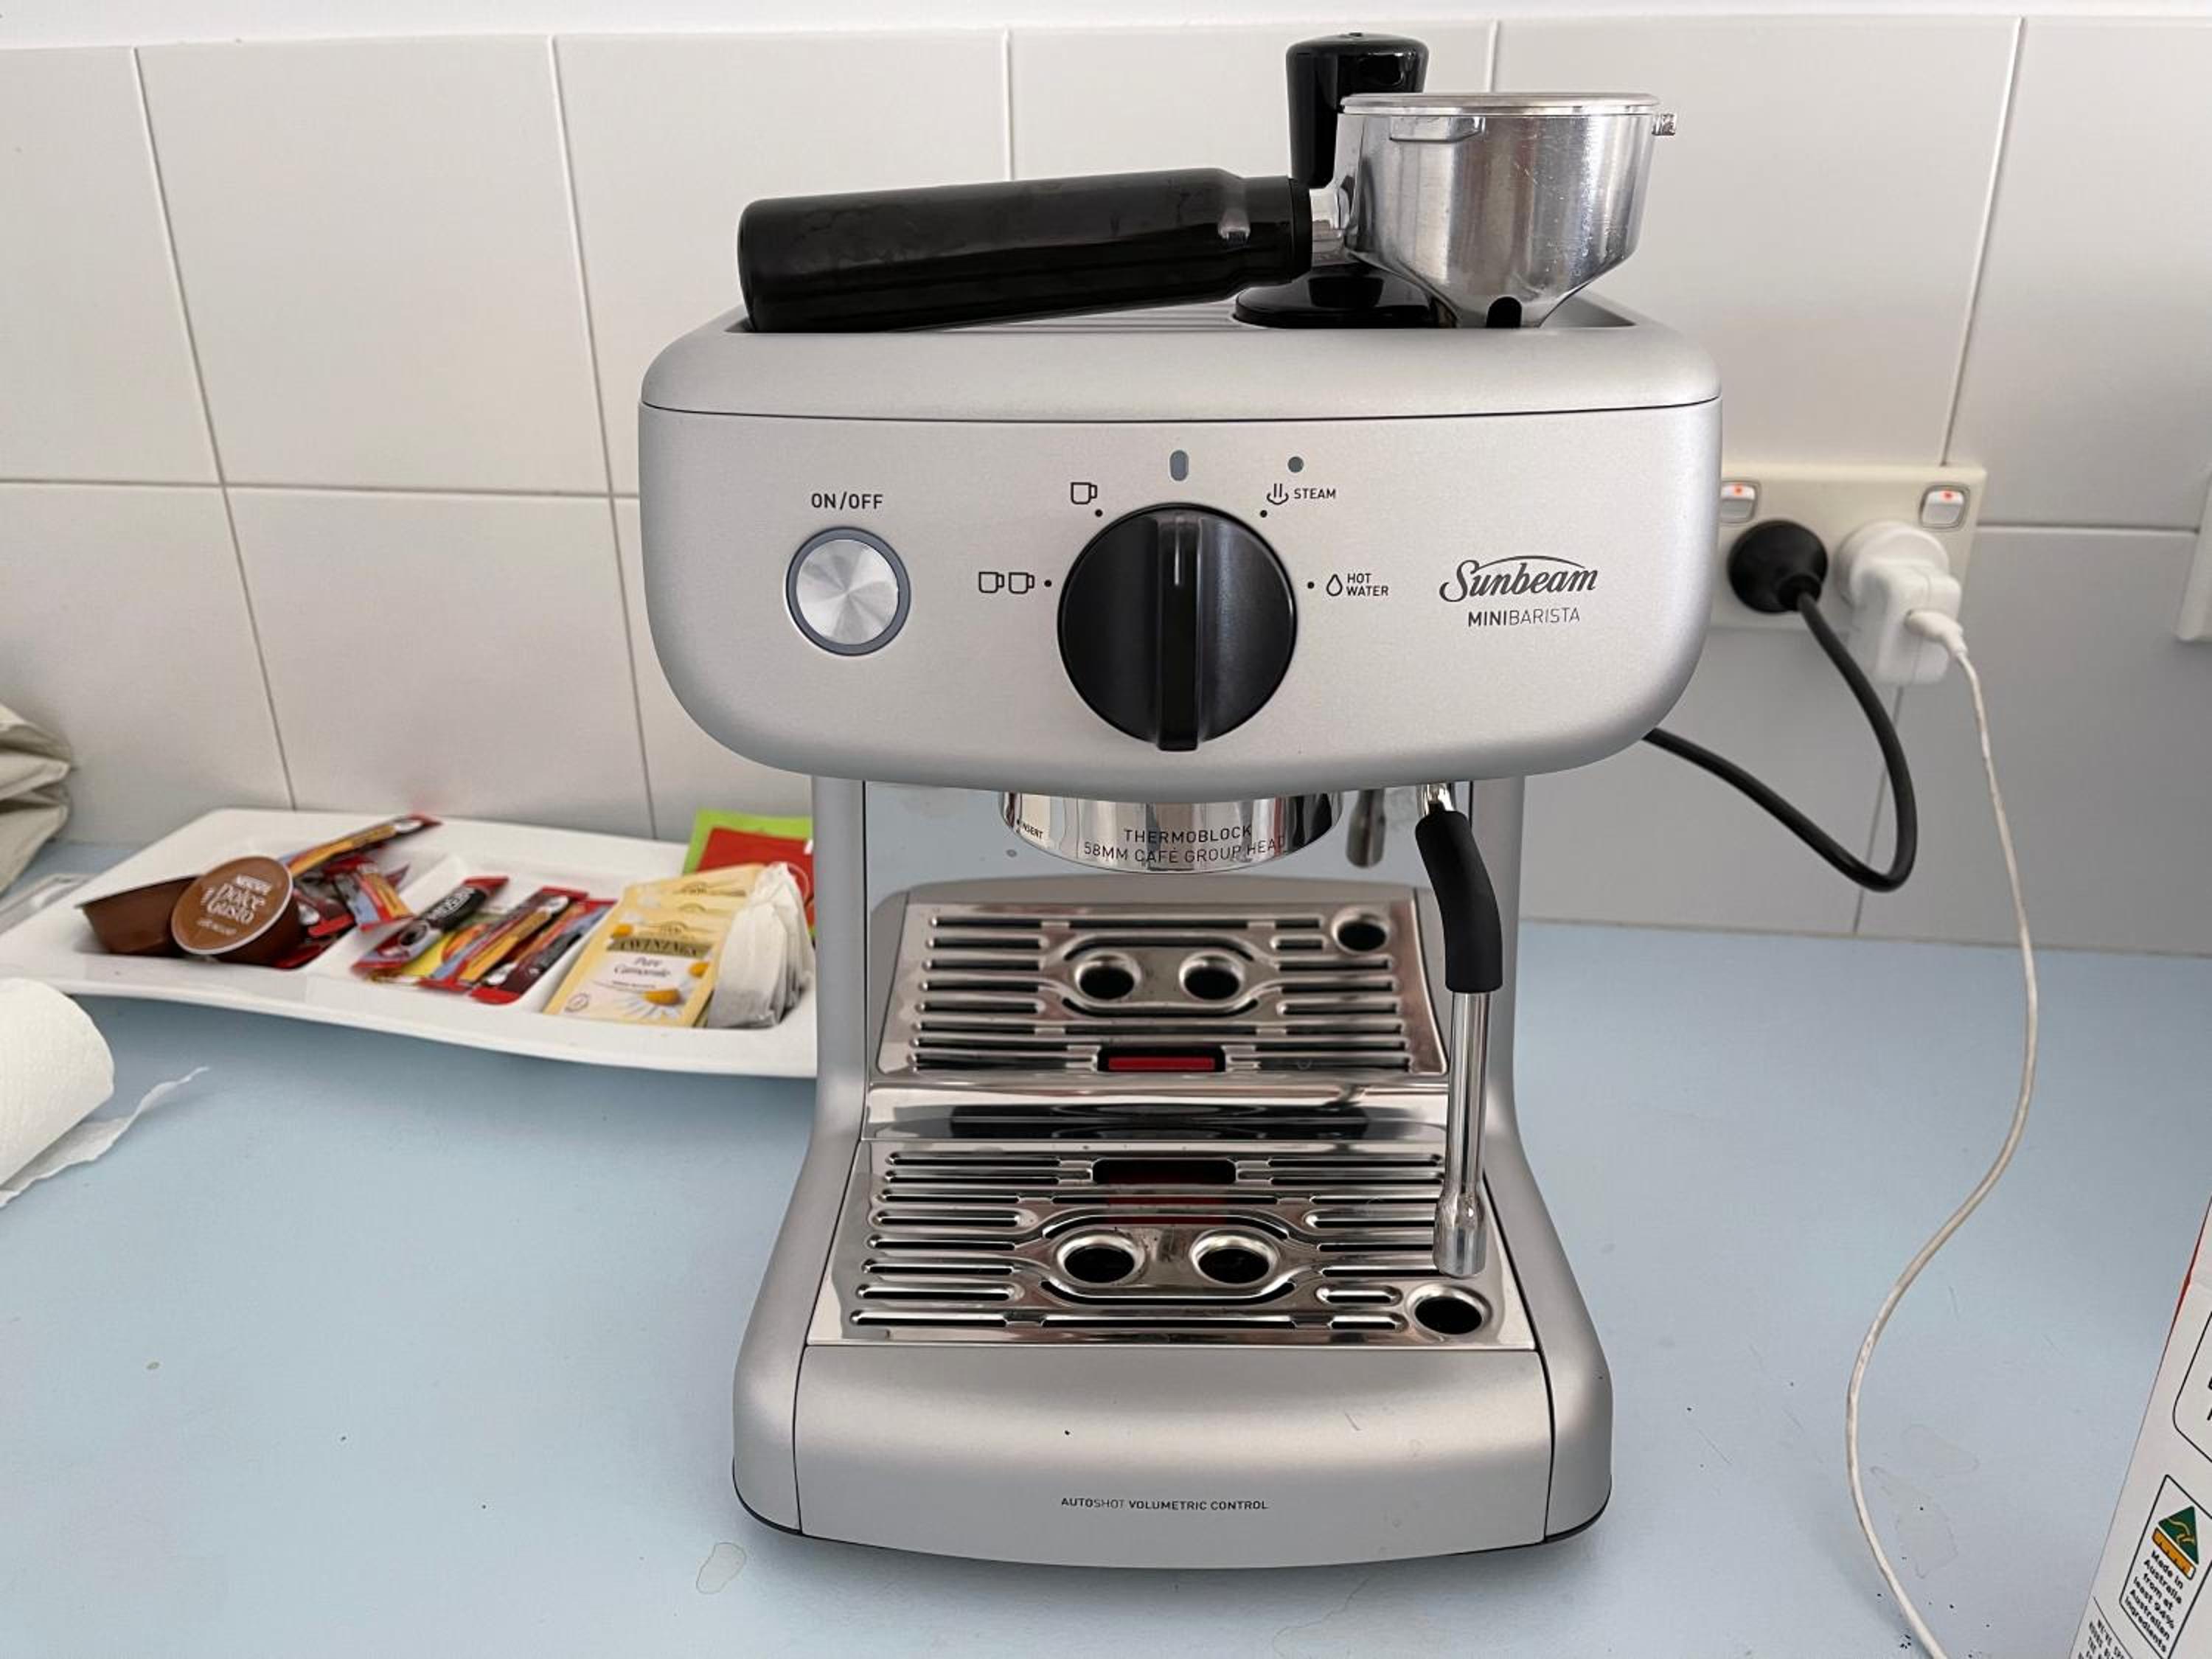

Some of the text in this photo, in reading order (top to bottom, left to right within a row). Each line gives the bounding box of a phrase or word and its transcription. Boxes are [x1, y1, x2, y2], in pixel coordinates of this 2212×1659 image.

[811, 492, 883, 510] ON/OFF
[1294, 487, 1336, 500] STEAM
[1346, 585, 1389, 597] WATER
[1347, 573, 1372, 584] HOT
[1439, 556, 1599, 602] Sunbeam
[1467, 607, 1580, 627] MINIBARISTA
[1124, 824, 1253, 844] THERMOBLOCK
[1083, 841, 1129, 862] 58MM
[1184, 845, 1241, 863] GROUP
[1247, 835, 1286, 856] HEAD
[1061, 1498, 1269, 1511] AUTOSHOT VOLUMETRIC CONTROL
[2143, 1559, 2183, 1604] Australia
[2152, 1549, 2184, 1590] Made in
[2133, 1576, 2153, 1604] least
[2143, 1573, 2173, 1610] from at
[2125, 1596, 2166, 1652] ingredients
[2129, 1589, 2170, 1641] Australian
